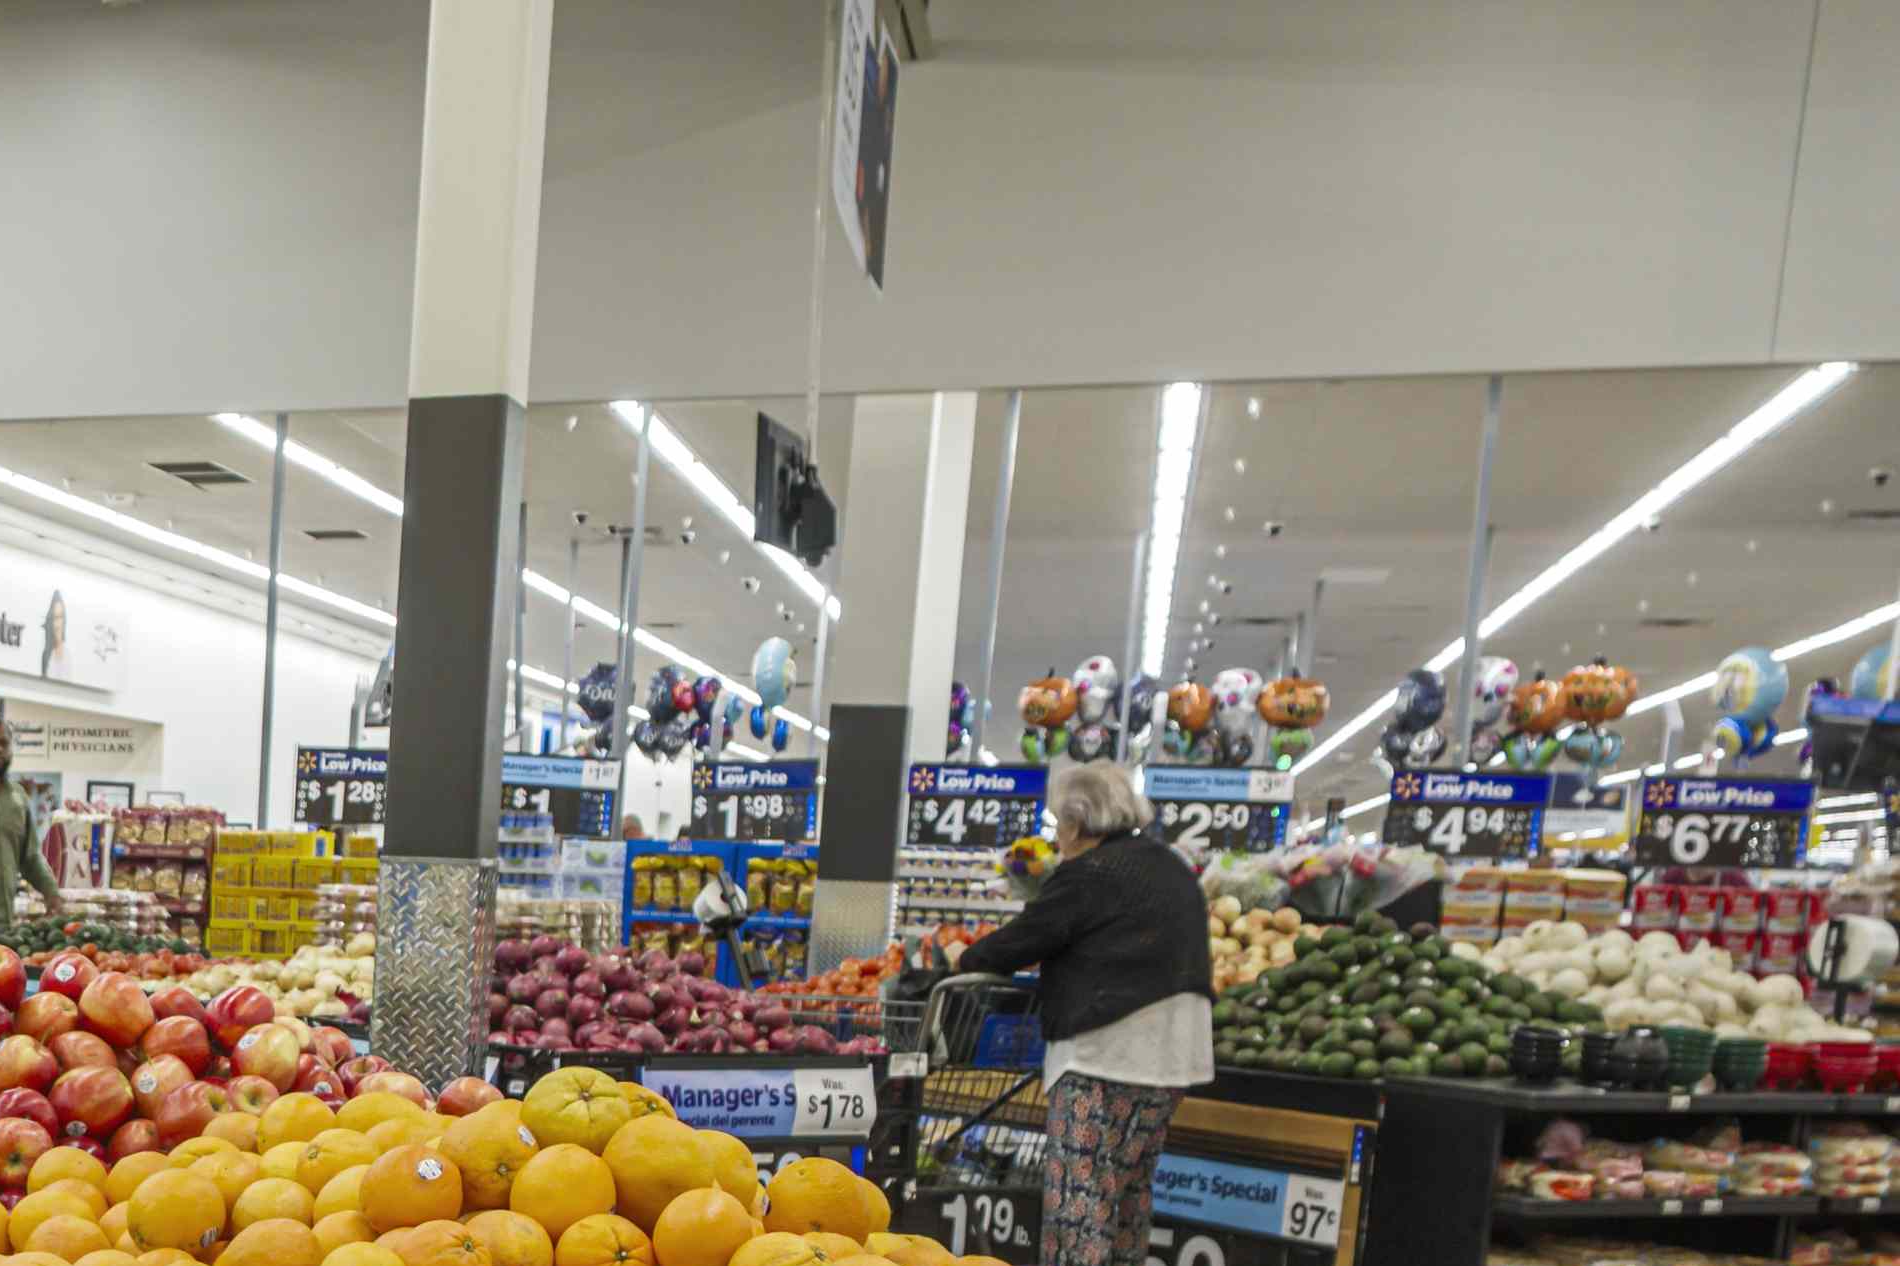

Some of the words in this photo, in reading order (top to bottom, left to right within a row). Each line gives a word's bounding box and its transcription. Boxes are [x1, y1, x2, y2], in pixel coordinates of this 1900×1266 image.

[52, 727, 133, 738] OPTOMETRIC
[53, 741, 135, 753] PHYSICIANS
[320, 756, 350, 770] Low
[351, 756, 388, 771] Price
[716, 768, 749, 785] Low
[749, 768, 788, 785] Price
[938, 771, 973, 789] Low
[974, 773, 1016, 790] Price
[1425, 776, 1464, 796] Low
[1466, 779, 1514, 799] Price
[1680, 782, 1722, 804] Low
[1724, 785, 1775, 807] Price
[662, 1084, 781, 1112] Manager's
[731, 1115, 776, 1128] gerente
[1211, 1175, 1278, 1204] Special
